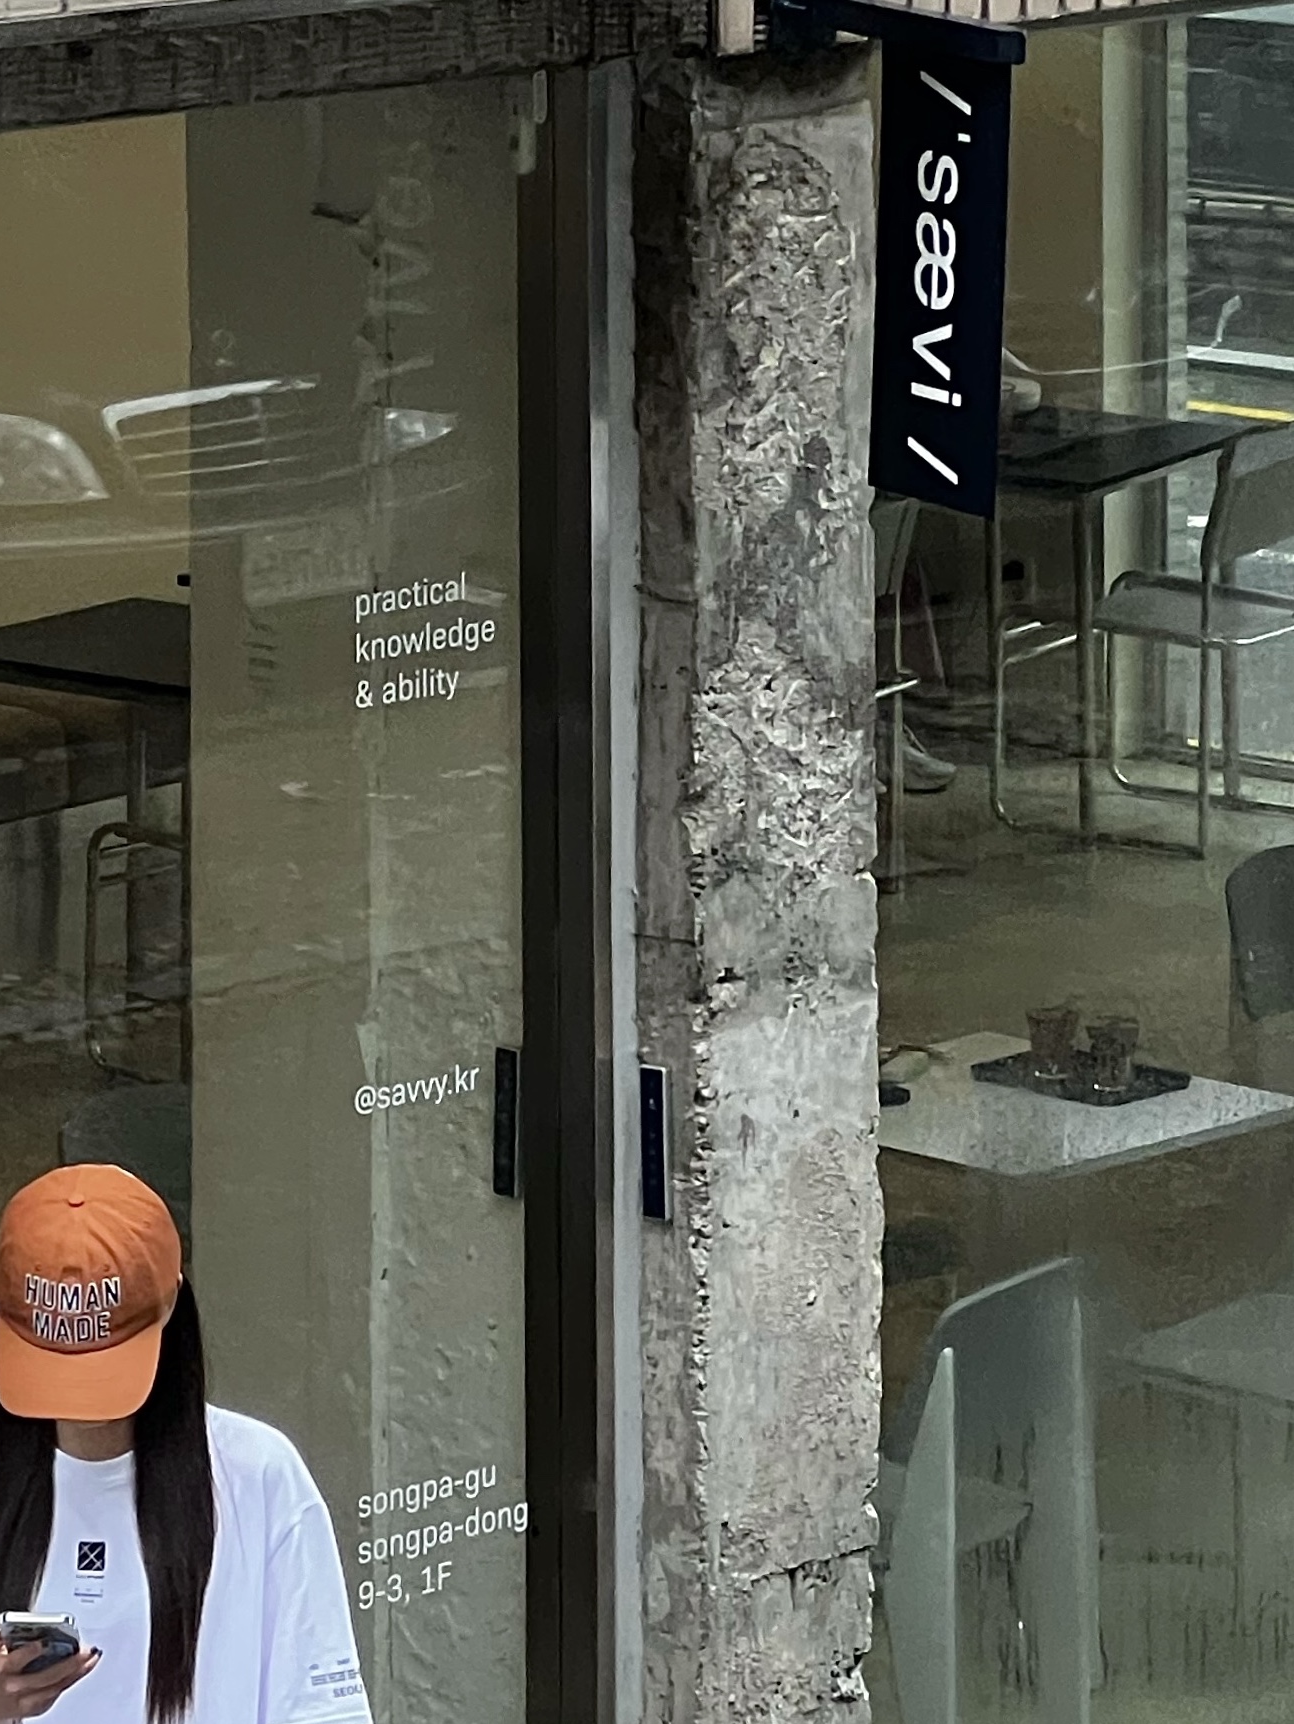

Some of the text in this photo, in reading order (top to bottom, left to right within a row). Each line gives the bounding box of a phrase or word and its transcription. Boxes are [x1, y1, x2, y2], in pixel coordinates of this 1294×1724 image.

[355, 571, 466, 623] practical
[355, 617, 496, 663] knowledge
[355, 668, 460, 709] & ability
[354, 1064, 480, 1115] @savvy.kr
[24, 1273, 121, 1313] HUMAN
[33, 1311, 112, 1344] MADE
[358, 1464, 497, 1519] songpa-gu
[358, 1501, 529, 1564] songpa-dong
[358, 1560, 453, 1610] 9-3, 1F
